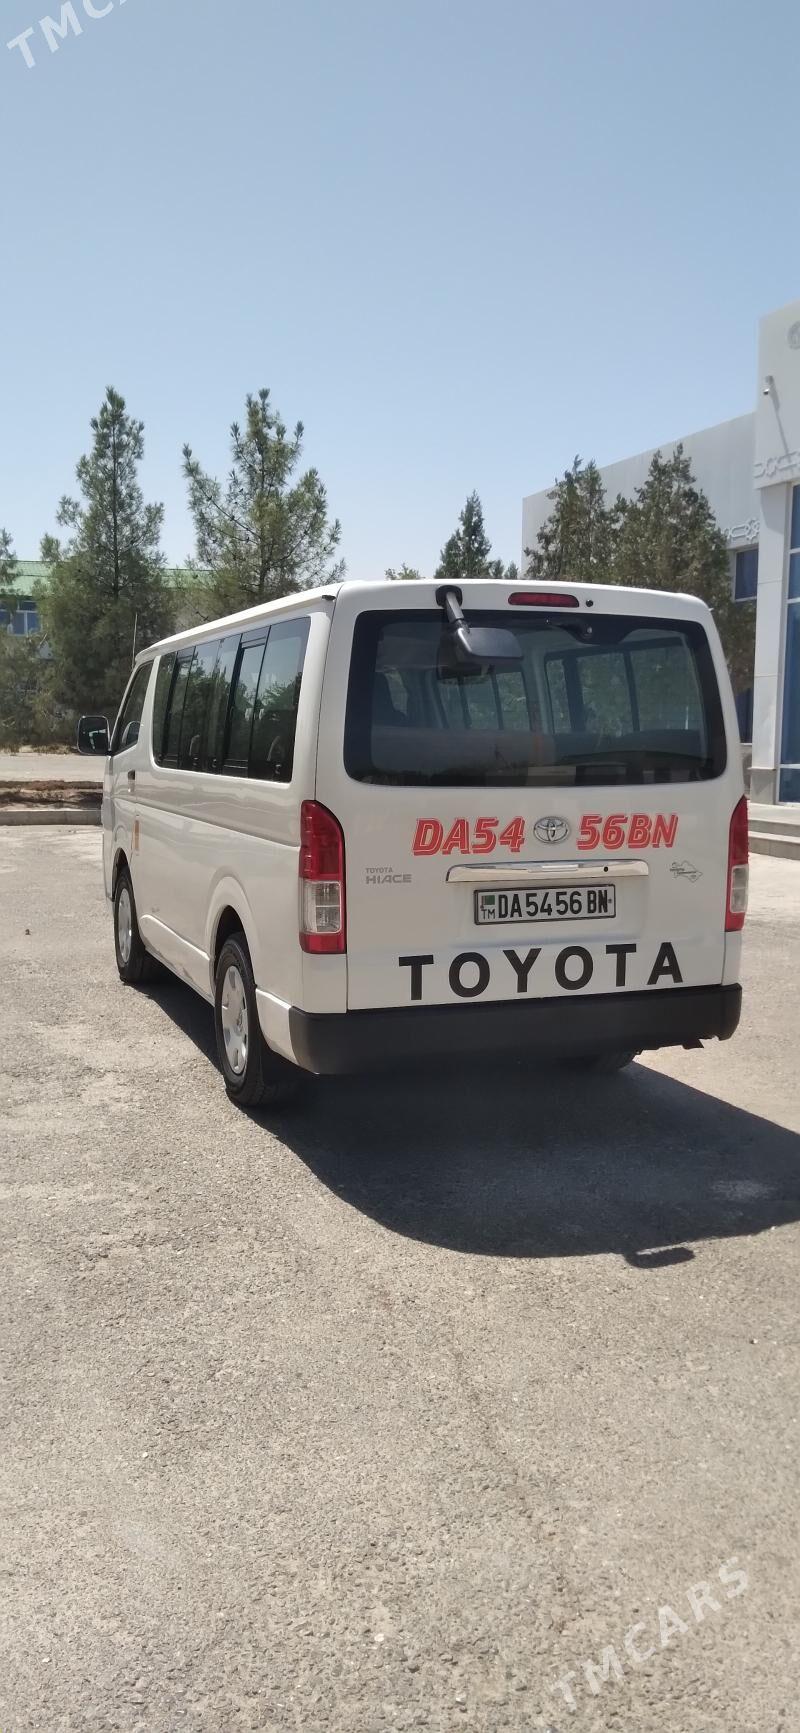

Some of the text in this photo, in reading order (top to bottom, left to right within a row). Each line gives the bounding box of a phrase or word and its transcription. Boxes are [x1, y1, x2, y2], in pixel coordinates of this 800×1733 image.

[411, 813, 679, 856] DA54 56BN
[365, 874, 412, 884] HIACE
[481, 908, 496, 920] TM
[398, 941, 683, 1000] TOYOTA
